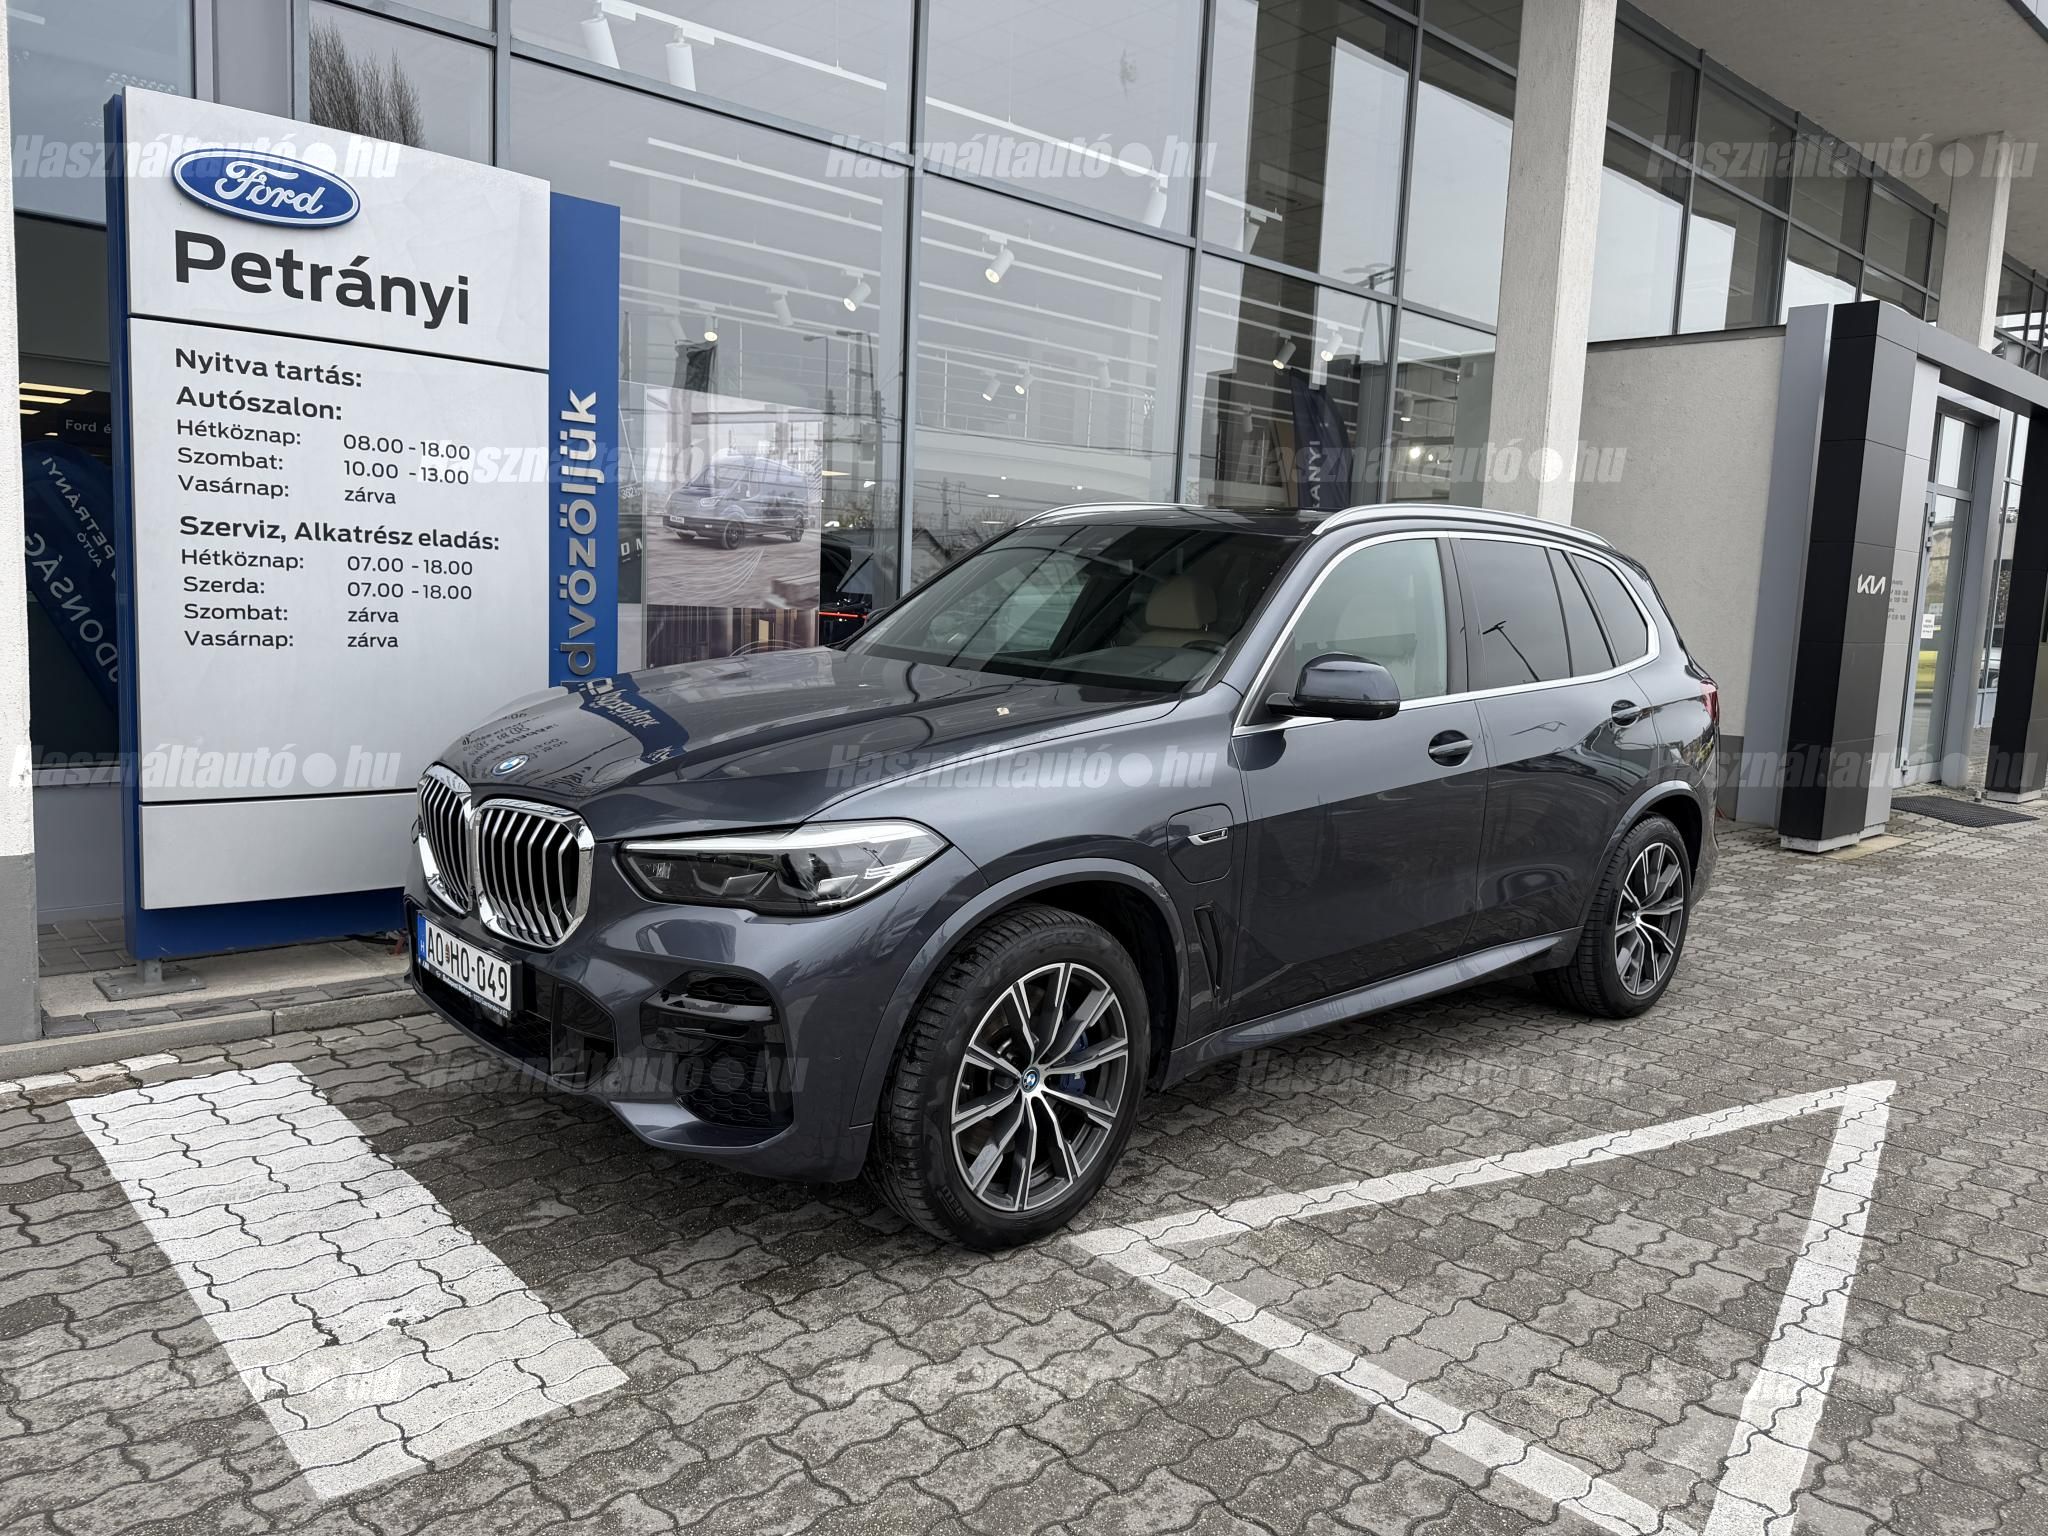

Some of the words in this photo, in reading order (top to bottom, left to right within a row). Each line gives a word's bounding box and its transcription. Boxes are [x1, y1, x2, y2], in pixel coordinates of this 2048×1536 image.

[214, 160, 326, 215] Ford
[175, 230, 469, 330] Petrányi
[176, 348, 268, 377] Nyitva
[275, 361, 362, 387] tartás:
[176, 386, 342, 420] Autószalon:
[65, 419, 97, 433] Ford
[177, 419, 301, 447] Hétköznap:
[344, 434, 404, 454] 08.00
[421, 441, 470, 460] 18.00
[177, 447, 283, 470] Szombat:
[344, 460, 399, 479] 10.00
[421, 466, 469, 485] 13.00
[178, 475, 289, 500] Vasárnap:
[344, 487, 396, 505] zárva
[180, 516, 286, 543] Szerviz,
[294, 522, 413, 547] Alkatrész
[419, 529, 499, 551] eladás:
[560, 389, 604, 683] dvözöljük
[181, 548, 304, 572] Hétköznap:
[348, 556, 404, 573] 07.00
[423, 560, 473, 576] 18.00
[183, 576, 265, 594] Szerda:
[348, 582, 404, 598] 07.00
[423, 585, 472, 600] 18.00
[1857, 573, 1886, 595] KIA
[184, 603, 288, 621] Szombat:
[348, 607, 399, 623] zárva
[184, 630, 294, 650] Vasárnap:
[348, 633, 399, 648] zárva
[427, 926, 444, 967] AO
[450, 940, 508, 1002] HO-049
